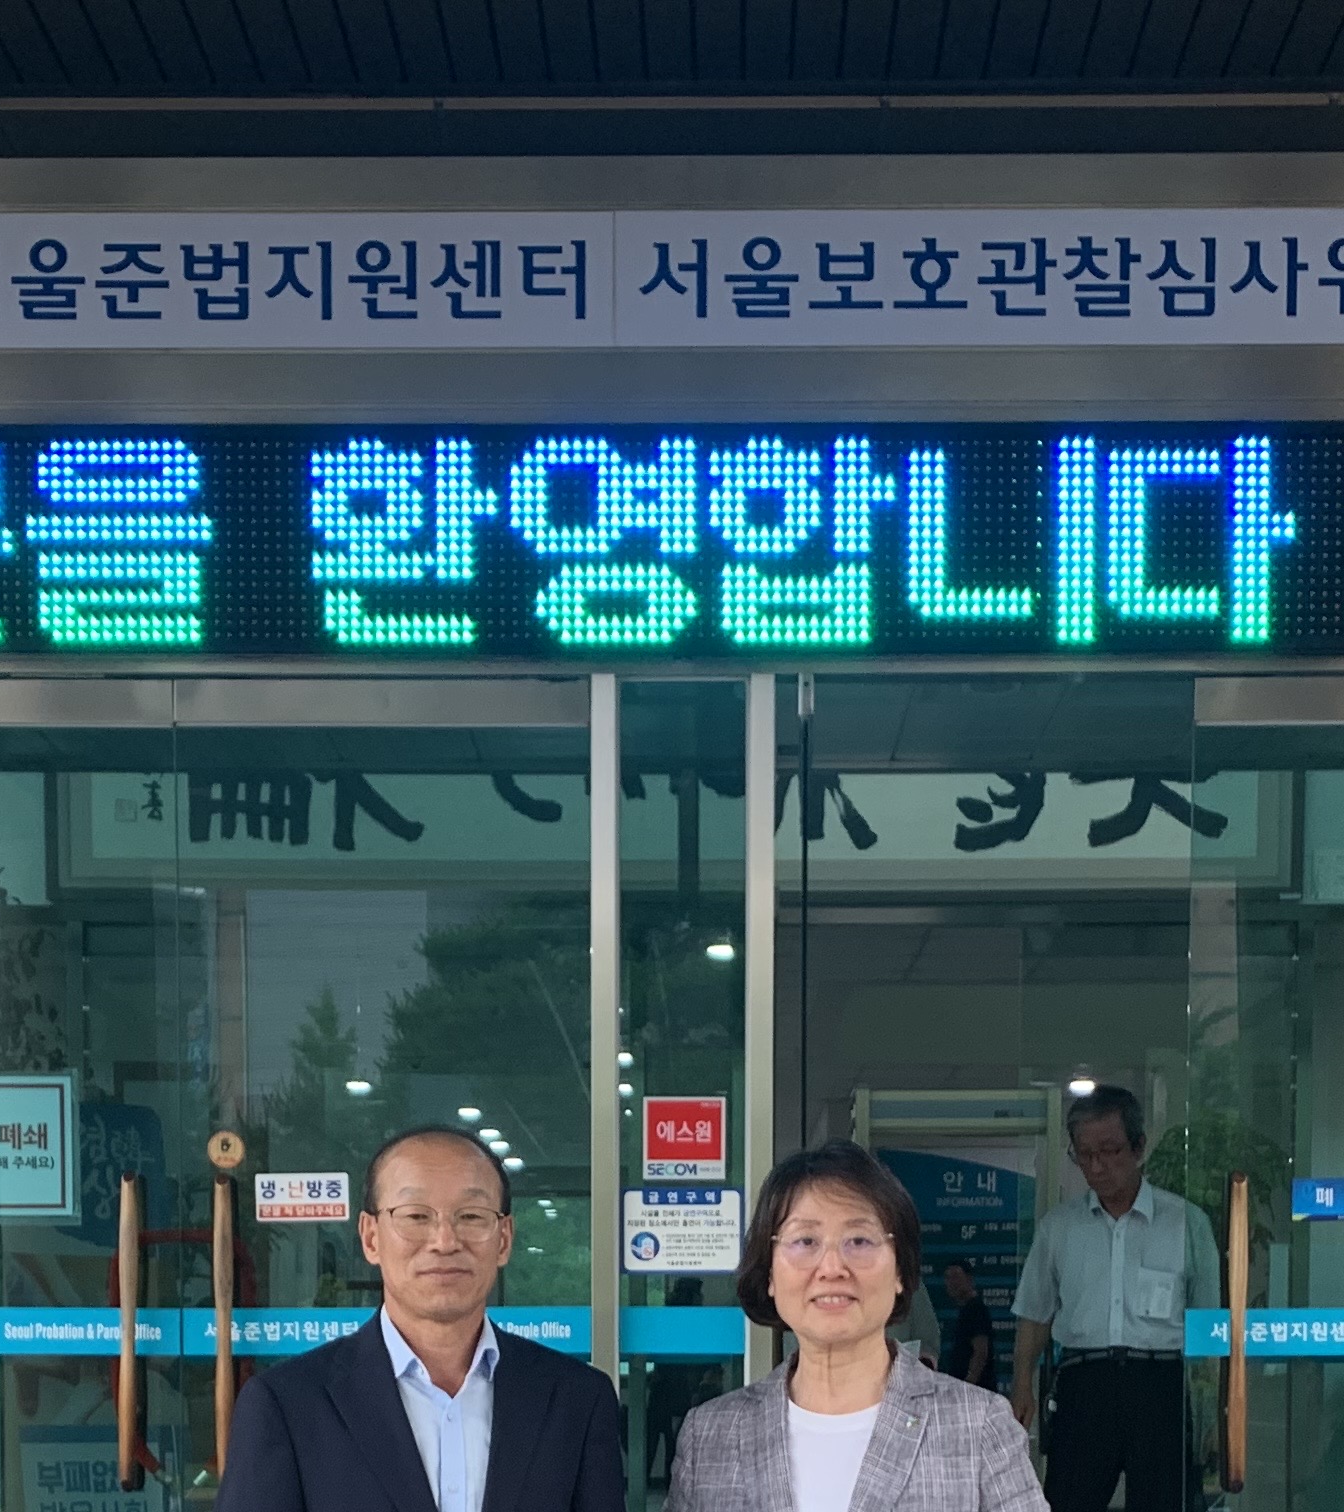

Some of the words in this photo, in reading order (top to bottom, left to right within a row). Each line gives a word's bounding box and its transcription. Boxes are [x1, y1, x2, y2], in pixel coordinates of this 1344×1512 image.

[310, 435, 1296, 646] 환영합니다
[656, 1120, 712, 1143] 에스원
[647, 1163, 698, 1176] SECOM
[4, 1322, 34, 1339] Seoul
[35, 1322, 84, 1340] Probation
[86, 1323, 94, 1339] &
[97, 1323, 122, 1340] Paro
[542, 1321, 571, 1339] Office
[37, 1460, 145, 1493] 부패없
